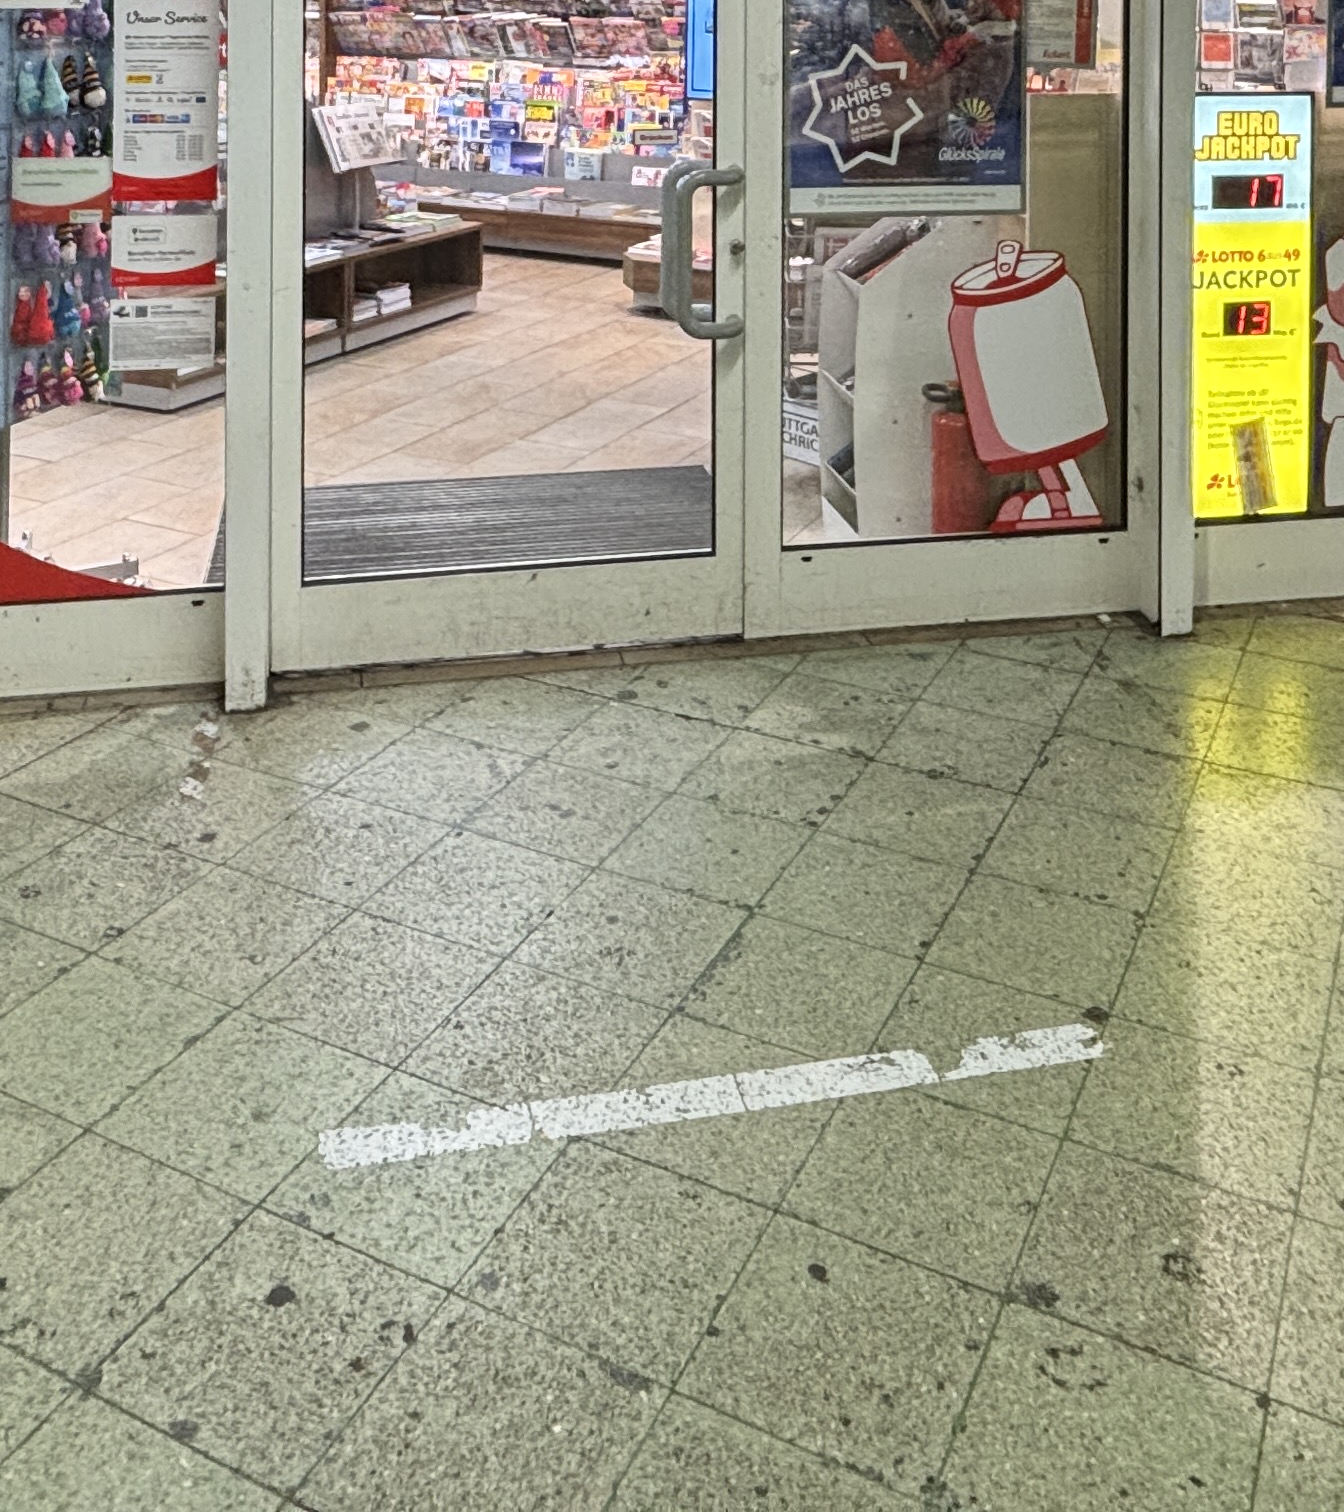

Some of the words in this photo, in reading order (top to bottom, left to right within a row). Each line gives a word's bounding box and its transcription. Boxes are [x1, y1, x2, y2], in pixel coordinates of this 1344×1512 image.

[164, 10, 208, 26] Service
[845, 76, 870, 92] DAS
[830, 82, 893, 114] JAHRES
[847, 103, 882, 125] LOS
[1217, 110, 1279, 137] EURO
[1193, 133, 1301, 161] JACKPOT
[1250, 175, 1282, 207] 17
[1212, 250, 1254, 263] LOTTO
[1193, 268, 1301, 289] JACKPOT
[1237, 303, 1269, 334] 13
